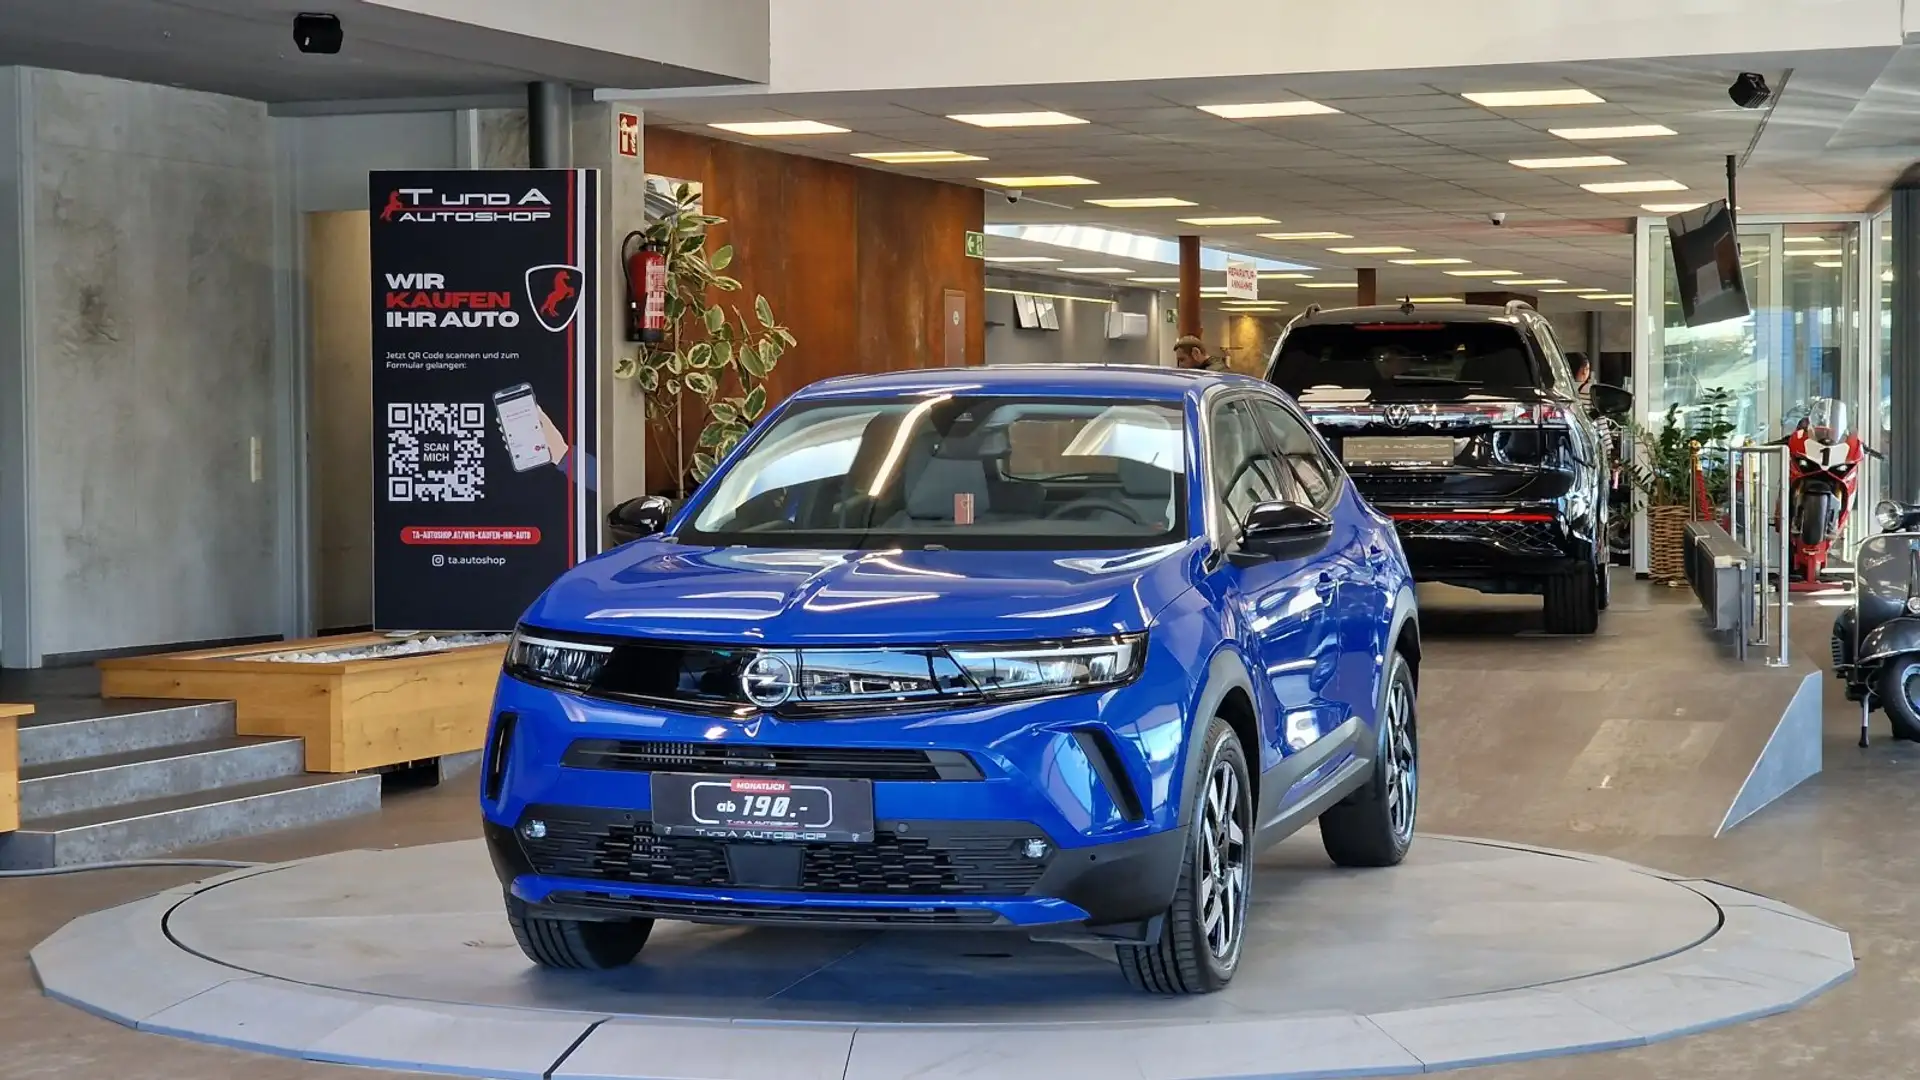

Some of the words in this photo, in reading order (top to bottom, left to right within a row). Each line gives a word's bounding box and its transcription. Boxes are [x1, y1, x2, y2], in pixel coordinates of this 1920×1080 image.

[399, 188, 433, 205] T
[518, 188, 551, 205] A
[399, 212, 551, 222] AUTOSHOP
[386, 273, 445, 289] WIR
[386, 291, 511, 308] KAUFEN
[386, 312, 437, 327] IHR
[439, 311, 520, 327] AUTO
[386, 351, 406, 359] Jetzt
[407, 351, 421, 360] QR
[422, 351, 444, 359] Code
[482, 351, 500, 359] und
[386, 361, 424, 369] Formular
[425, 361, 467, 371] gelangen:
[423, 442, 450, 452] SCAN
[423, 452, 450, 462] MICH
[1819, 447, 1831, 466] 1
[448, 556, 506, 566] ta.autoshop
[736, 782, 785, 791] MONATLICH
[717, 800, 736, 813] ab
[727, 830, 738, 838] A
[743, 831, 827, 840] AUTOSHOP
